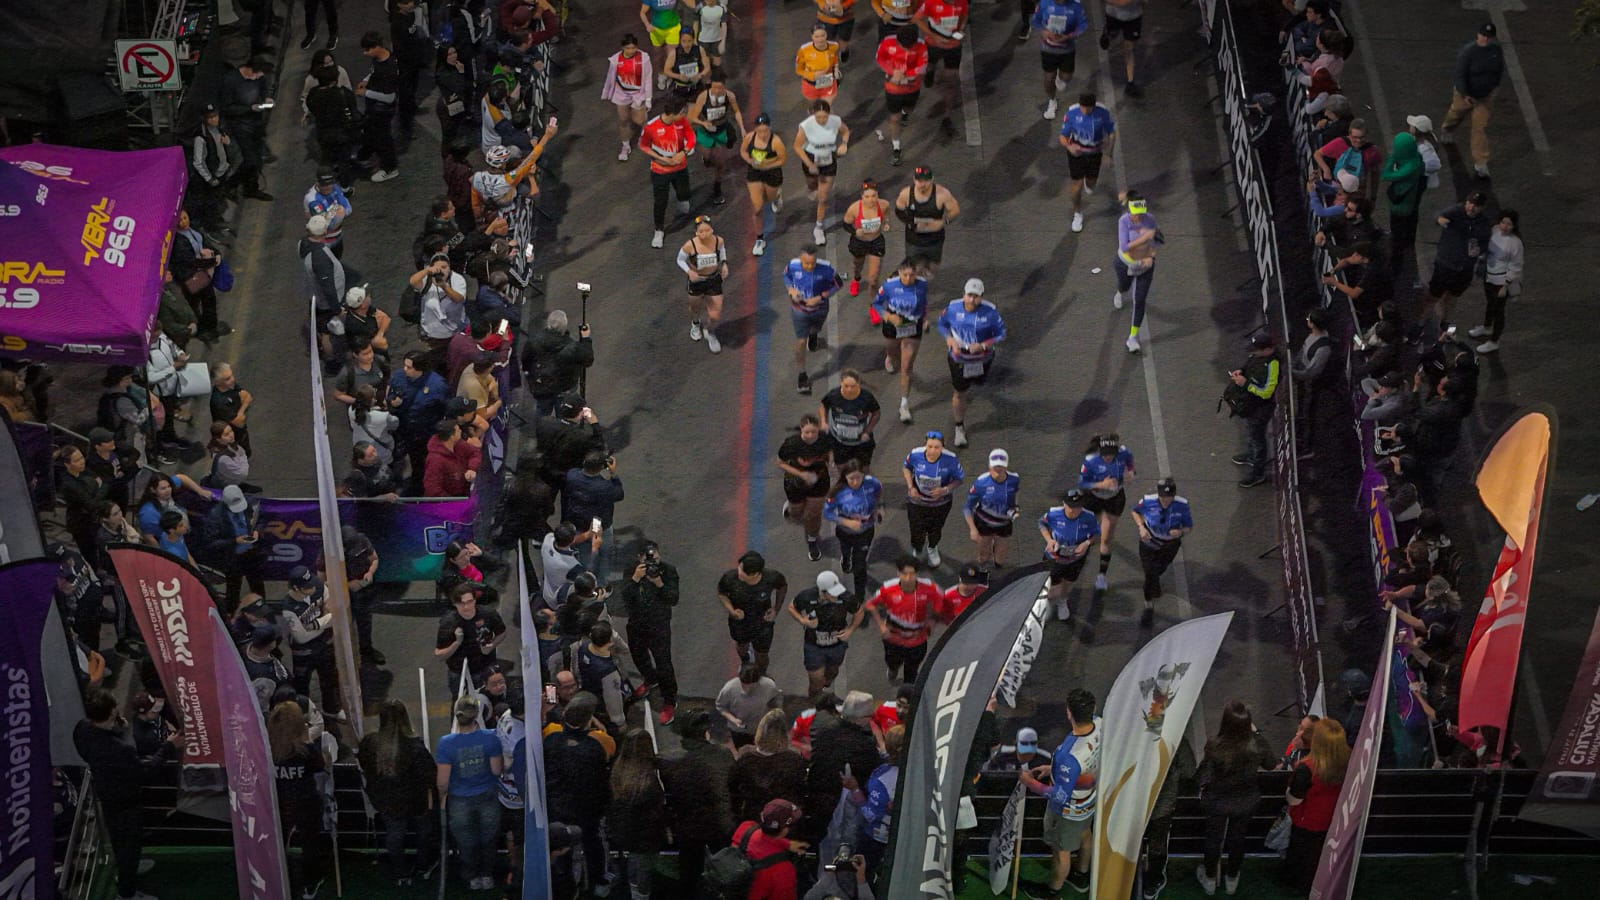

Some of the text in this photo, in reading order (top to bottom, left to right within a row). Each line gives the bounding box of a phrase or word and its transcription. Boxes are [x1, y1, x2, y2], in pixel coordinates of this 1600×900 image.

[81, 197, 109, 266] VIBRA
[104, 216, 136, 268] 96.9
[5, 667, 32, 856] Noticieristas
[272, 765, 305, 780] TAFF
